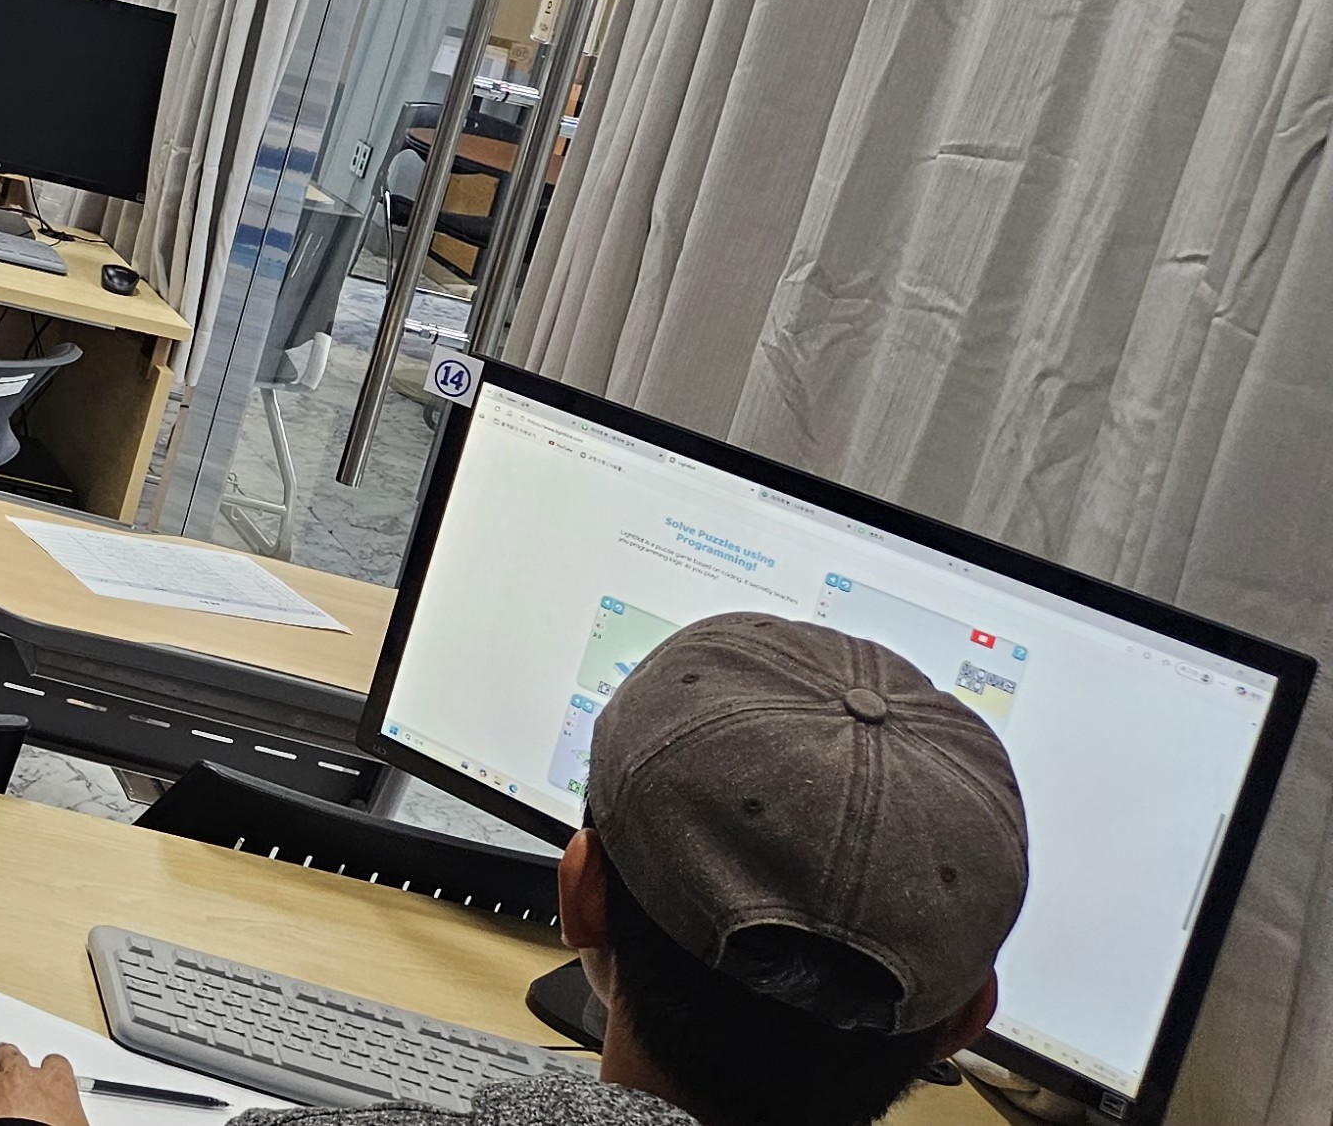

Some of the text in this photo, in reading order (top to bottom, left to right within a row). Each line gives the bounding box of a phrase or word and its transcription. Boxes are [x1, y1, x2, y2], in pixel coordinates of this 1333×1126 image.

[665, 516, 775, 568] Solve Puzzles using
[676, 533, 757, 572] Programming!
